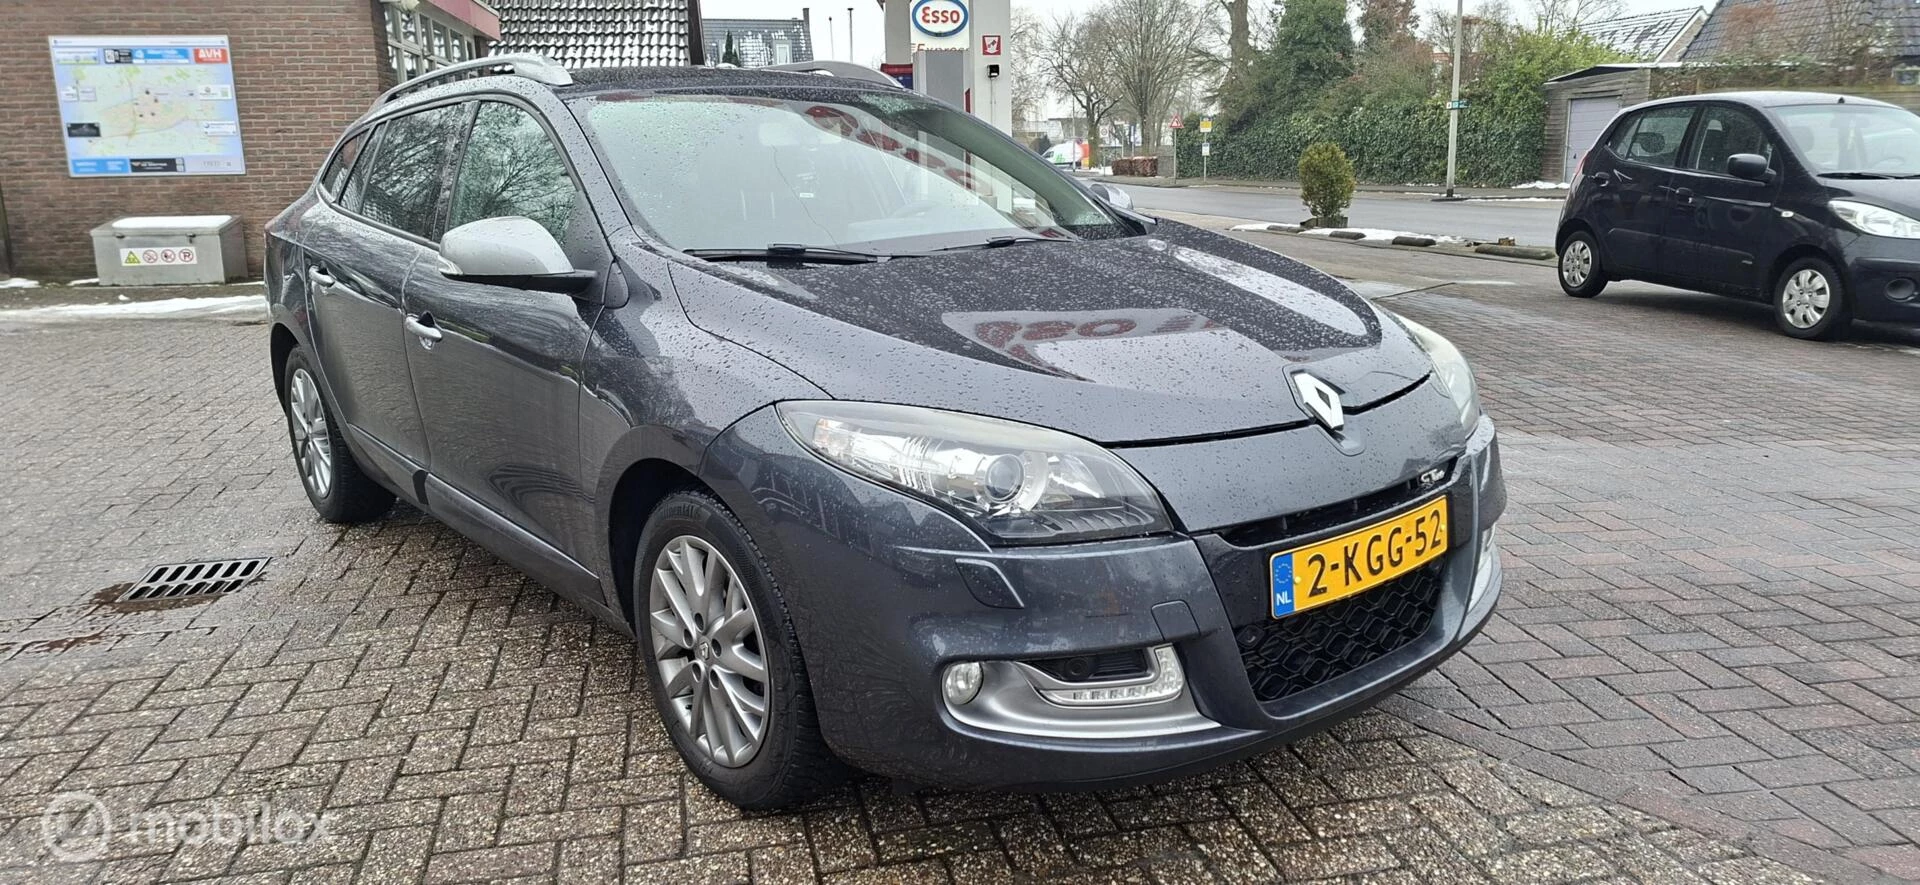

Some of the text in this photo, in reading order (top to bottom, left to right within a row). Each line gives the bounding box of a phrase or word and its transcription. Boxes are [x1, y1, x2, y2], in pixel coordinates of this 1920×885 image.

[921, 6, 960, 24] Esso
[198, 47, 222, 58] AVH
[1307, 509, 1442, 599] 2-KGG-52
[1276, 590, 1292, 606] NL
